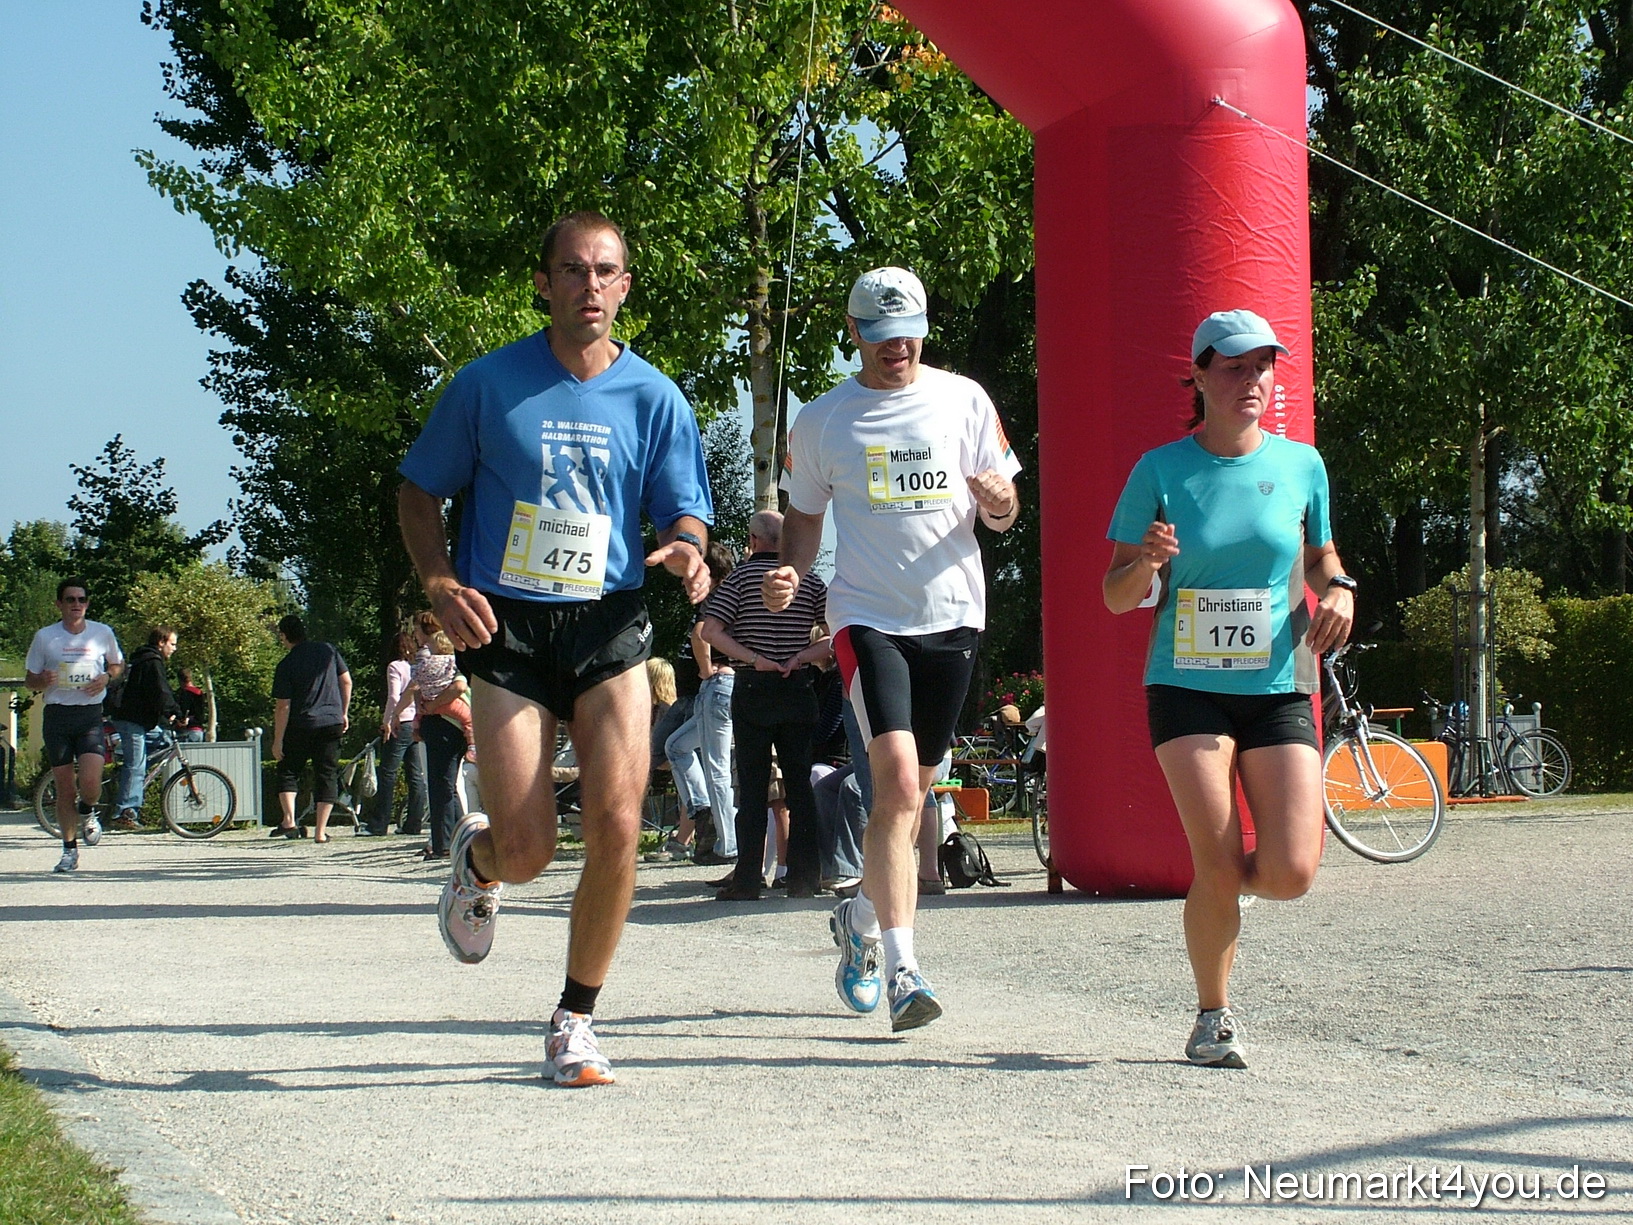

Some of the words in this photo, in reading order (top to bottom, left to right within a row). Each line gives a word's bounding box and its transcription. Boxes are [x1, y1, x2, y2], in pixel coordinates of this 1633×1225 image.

[1274, 384, 1286, 418] 1929
[541, 420, 555, 429] 20.
[557, 421, 612, 435] WALLENSTEIN
[541, 431, 609, 446] HALBMARATHON
[890, 446, 932, 463] Michael
[872, 471, 879, 482] C
[895, 470, 948, 492] 1002
[538, 518, 590, 538] michael
[512, 534, 520, 547] B
[543, 547, 593, 575] 475
[1198, 597, 1263, 612] Christiane
[1178, 620, 1185, 631] C
[1209, 625, 1256, 647] 176
[69, 675, 91, 683] 1214
